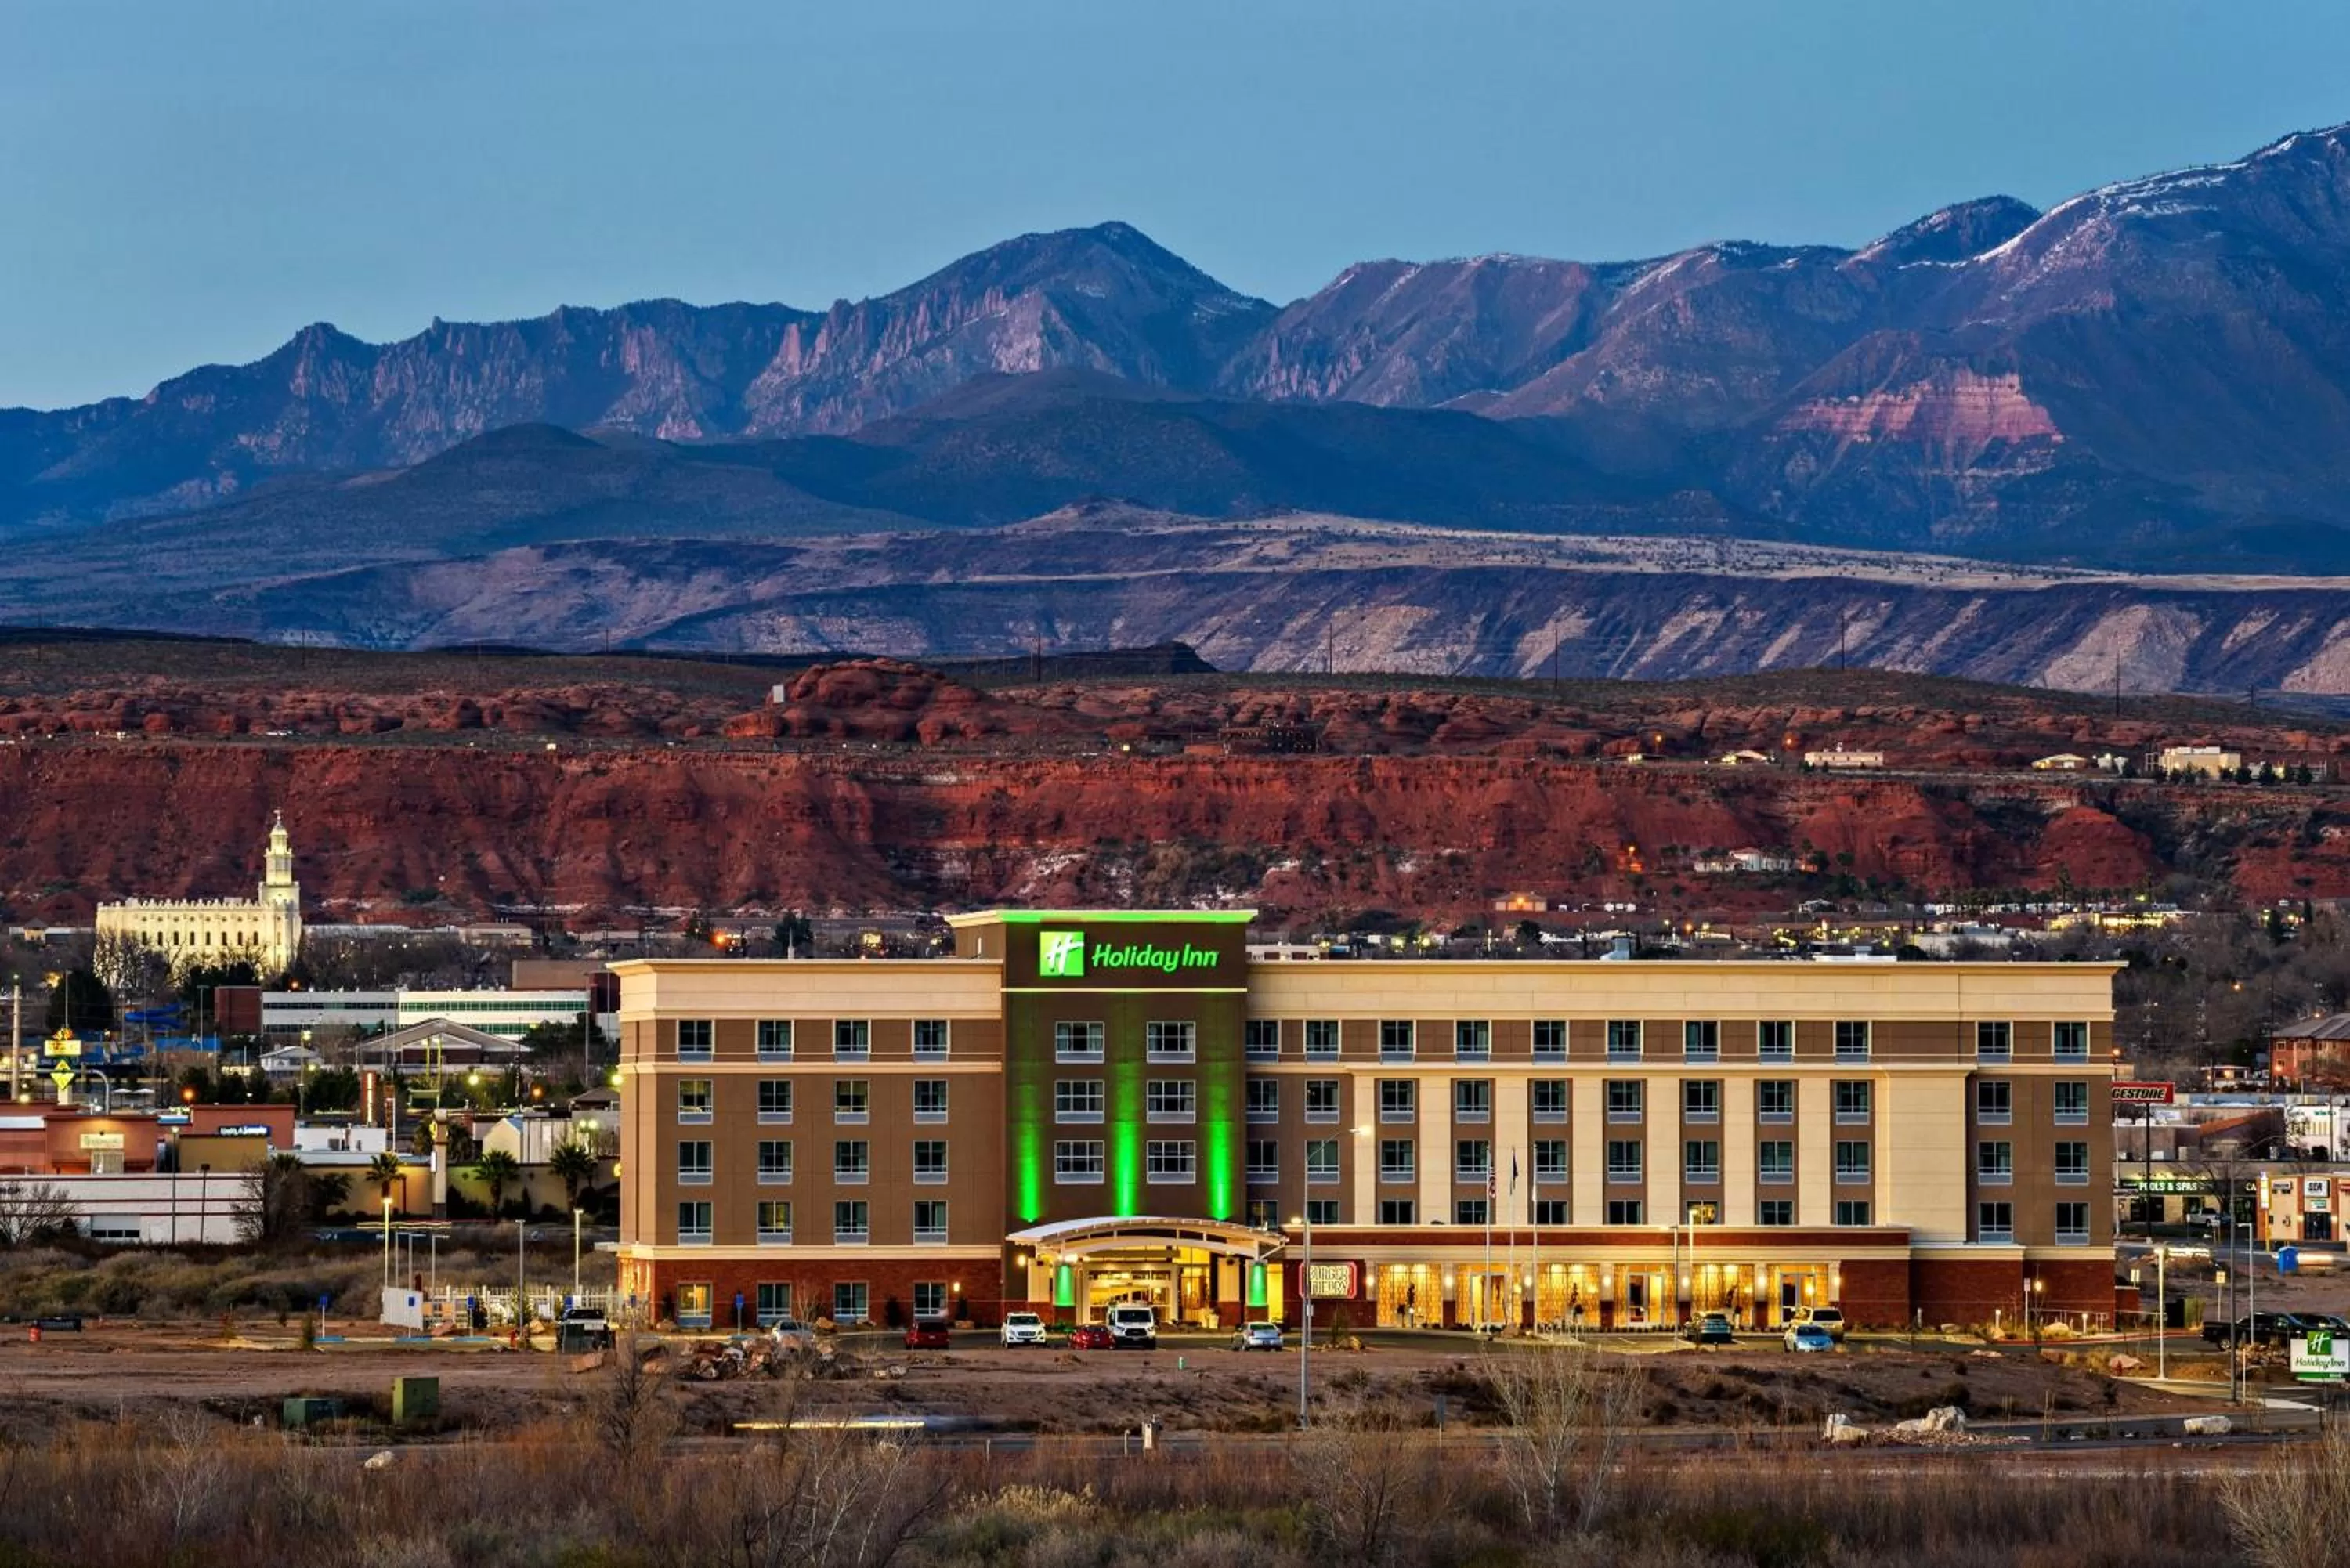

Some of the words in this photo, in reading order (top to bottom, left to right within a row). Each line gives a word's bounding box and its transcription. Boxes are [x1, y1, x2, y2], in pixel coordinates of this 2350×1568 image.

[1092, 944, 1180, 973] Holiday
[1182, 943, 1219, 967] Inn
[2175, 1182, 2198, 1191] SPAS
[2295, 1357, 2330, 1369] Holiday
[2330, 1357, 2345, 1367] Inn
